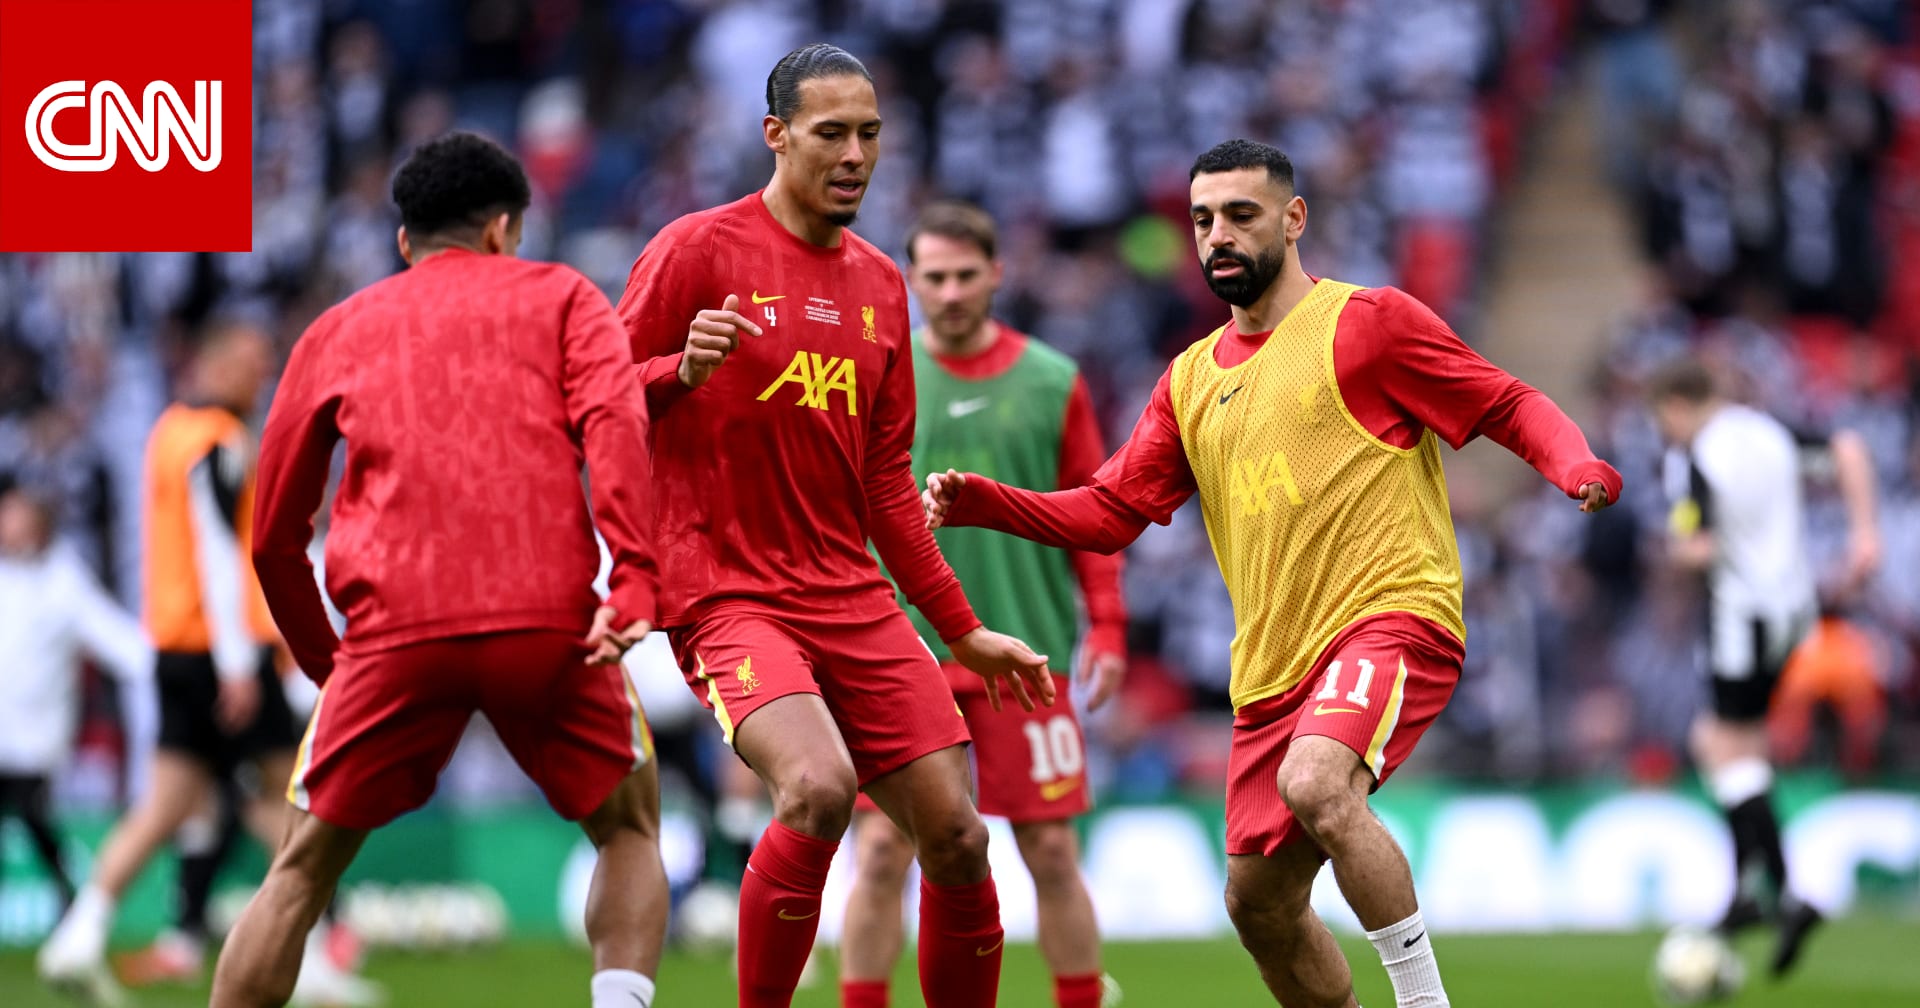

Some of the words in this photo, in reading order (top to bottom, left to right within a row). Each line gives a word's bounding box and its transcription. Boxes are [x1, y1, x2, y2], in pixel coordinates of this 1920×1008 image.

[764, 306, 776, 327] 4
[756, 350, 857, 416] AXA
[1316, 659, 1376, 709] 11
[1023, 716, 1082, 782] 10
